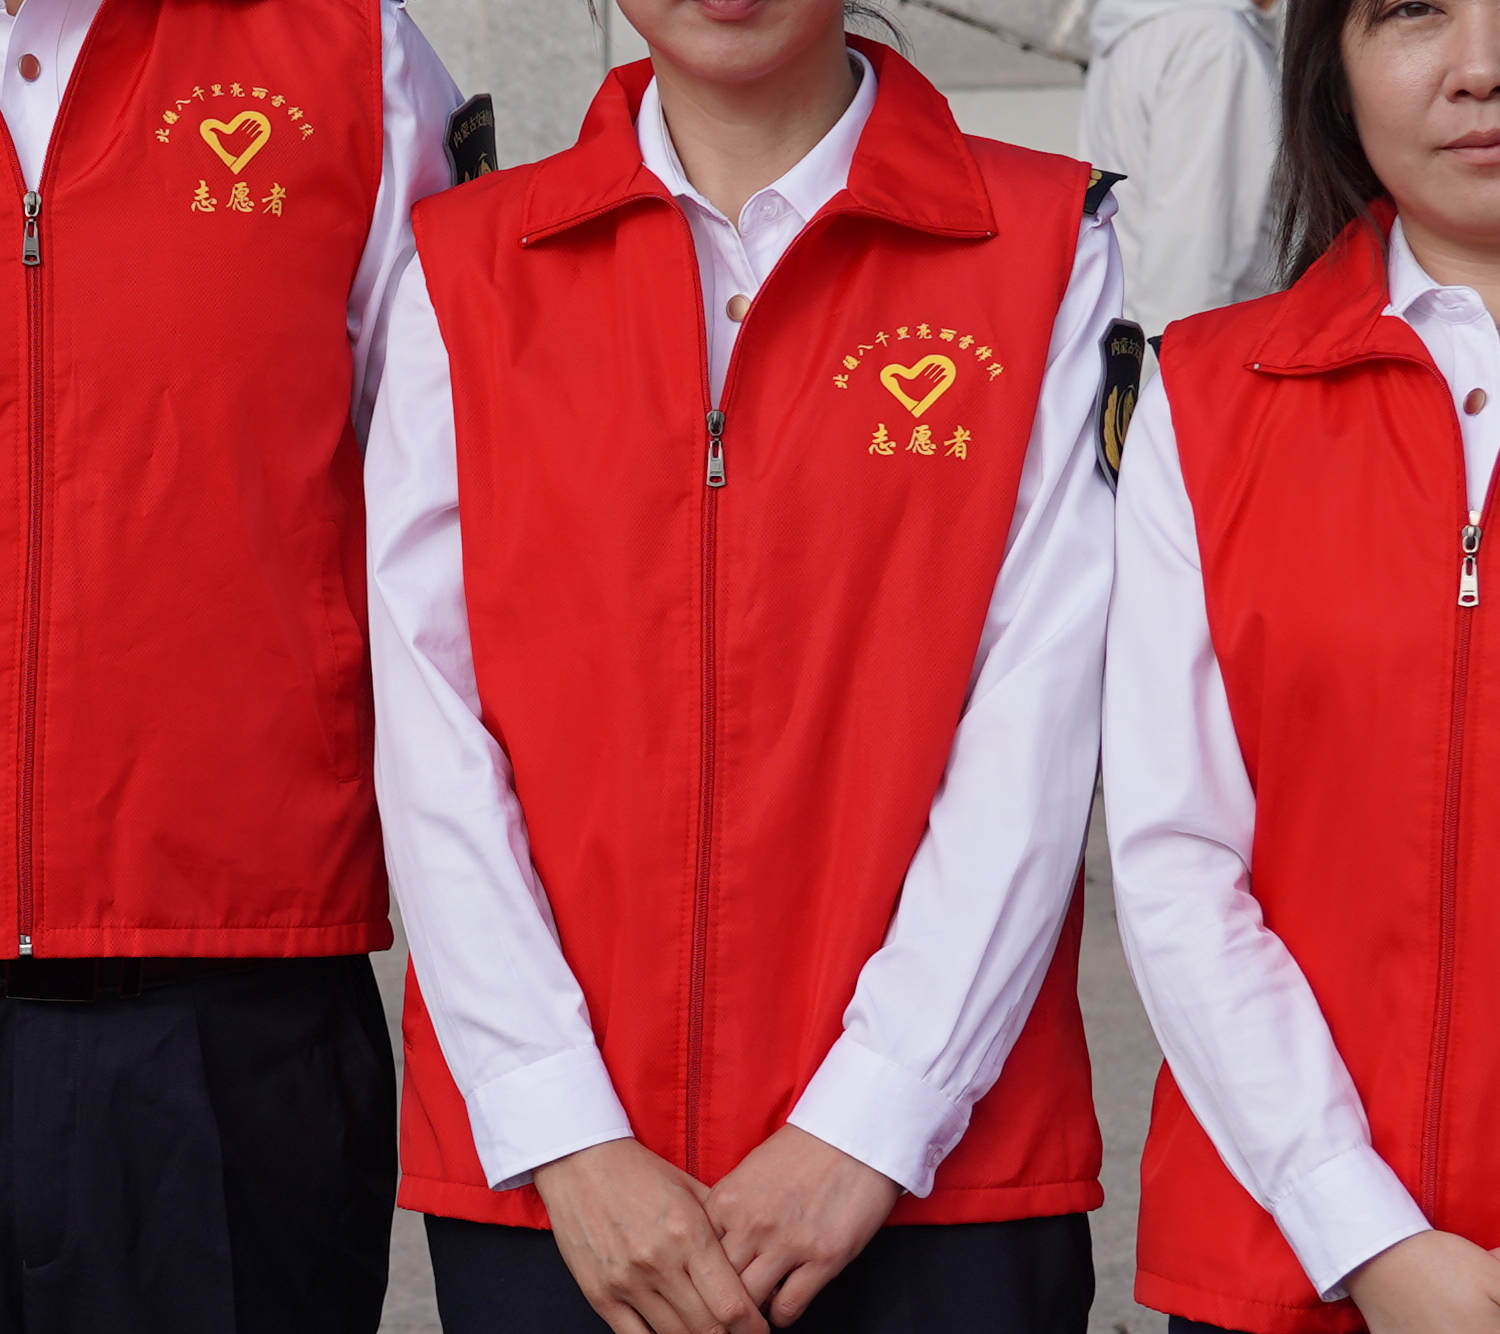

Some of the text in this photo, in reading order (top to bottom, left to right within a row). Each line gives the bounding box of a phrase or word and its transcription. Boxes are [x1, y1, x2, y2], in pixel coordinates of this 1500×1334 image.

[191, 180, 286, 217] 志愿者
[868, 423, 972, 460] 志愿者
